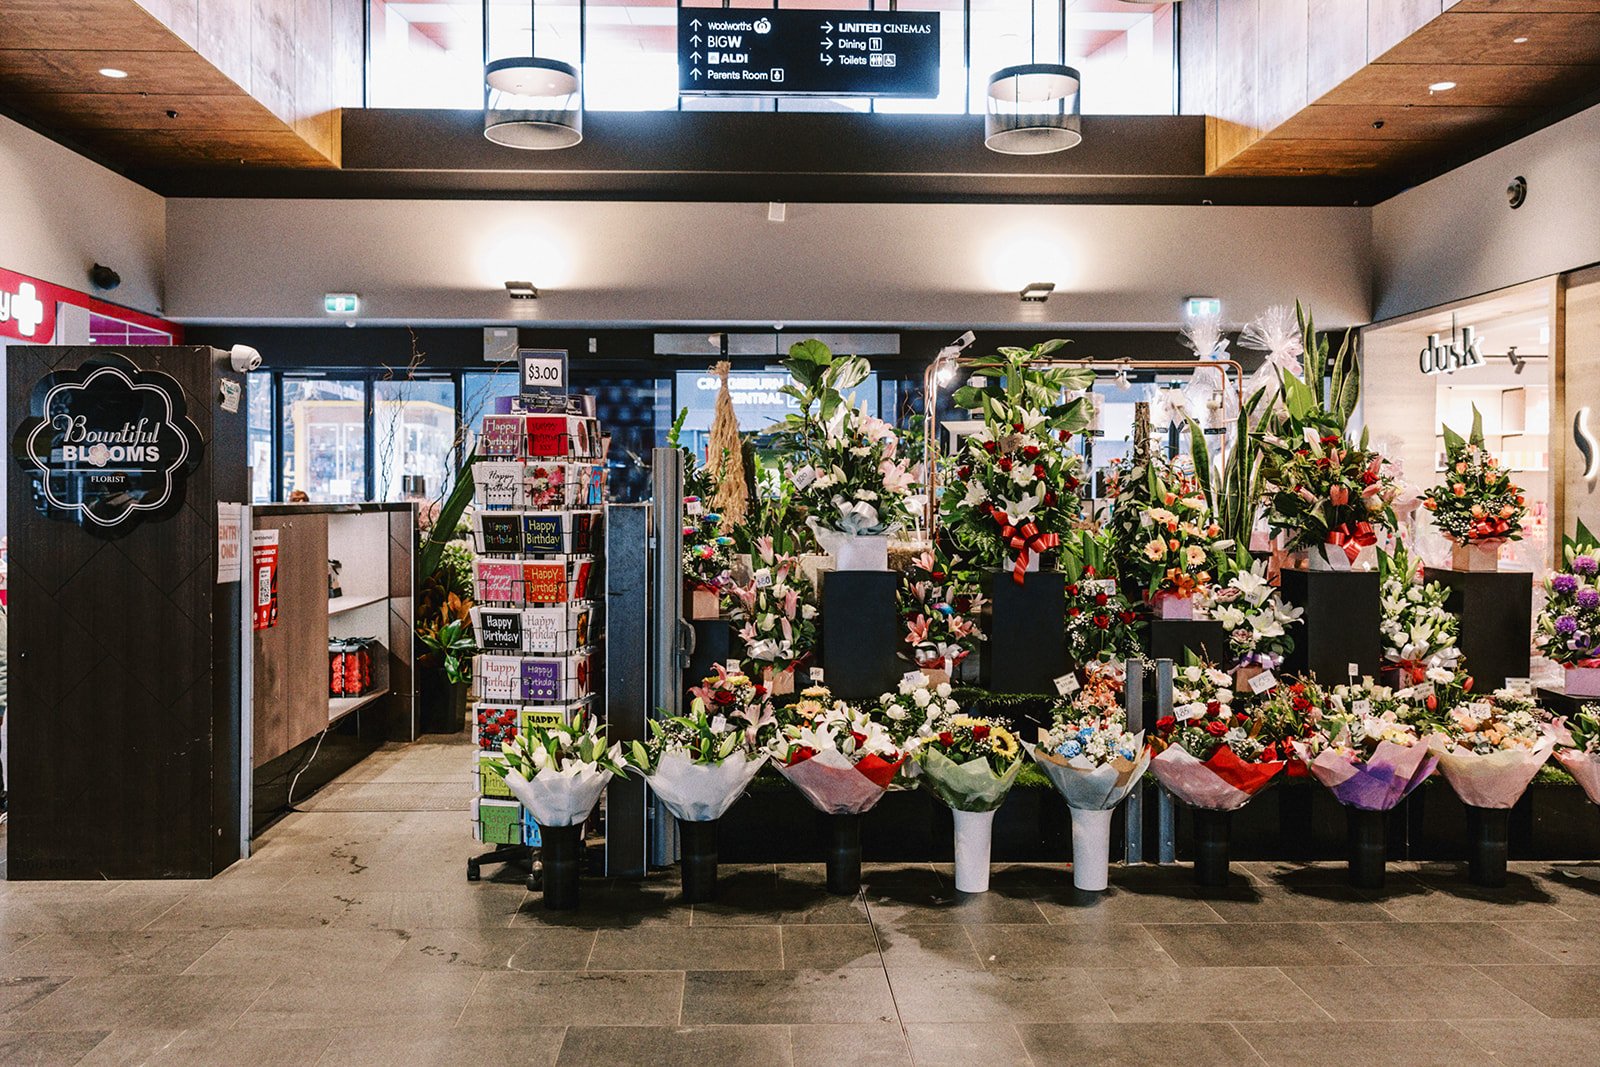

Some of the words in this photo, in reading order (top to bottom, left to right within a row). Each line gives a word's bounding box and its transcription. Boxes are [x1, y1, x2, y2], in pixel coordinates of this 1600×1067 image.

[838, 23, 881, 33] UNITED
[883, 24, 931, 34] CINEMAS
[838, 39, 867, 51] Dining
[720, 53, 749, 64] ALDI
[838, 55, 868, 65] Toilets
[707, 69, 741, 80] Parents
[742, 70, 768, 80] Room
[1419, 326, 1484, 374] dusk
[528, 363, 559, 381] $3.00
[52, 413, 161, 449] Bountiful
[485, 419, 517, 433] Happy
[483, 434, 518, 450] Birthday
[90, 475, 126, 483] FLORIST
[488, 469, 515, 482] Happy
[528, 519, 557, 533] Happy
[526, 533, 560, 545] Birthday
[220, 543, 239, 560] ONLY
[486, 615, 513, 629] Happy
[527, 614, 556, 629] Happy
[483, 629, 519, 644] Birthday
[485, 661, 518, 676] Happy
[527, 665, 553, 678] Happy
[527, 715, 560, 724] HAPPY
